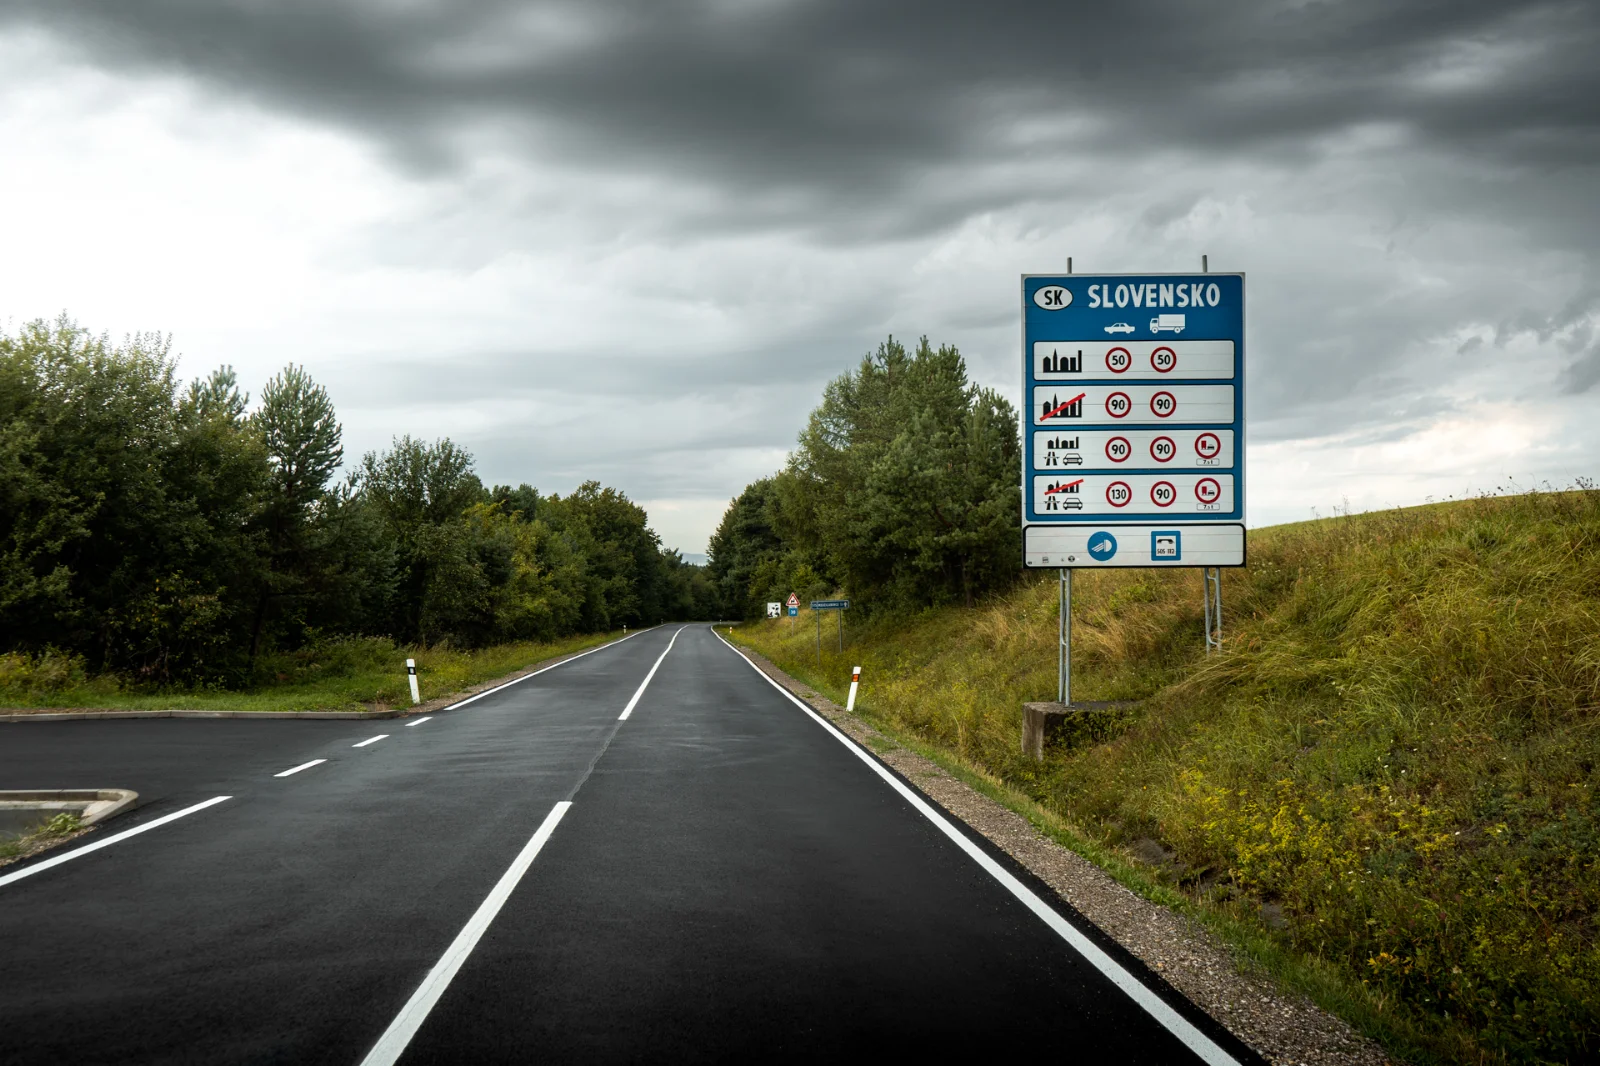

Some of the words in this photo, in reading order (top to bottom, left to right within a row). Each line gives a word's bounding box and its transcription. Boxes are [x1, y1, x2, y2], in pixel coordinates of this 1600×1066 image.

[1044, 290, 1063, 306] SK
[1087, 283, 1221, 308] SLOVENSKO
[1112, 355, 1125, 365] 50
[1157, 354, 1171, 365] 50
[1111, 399, 1125, 410] 90
[1156, 399, 1170, 410] 90
[1111, 444, 1125, 455] 90
[1156, 444, 1170, 454] 90
[1111, 489, 1127, 500] 130
[1156, 489, 1170, 499] 90
